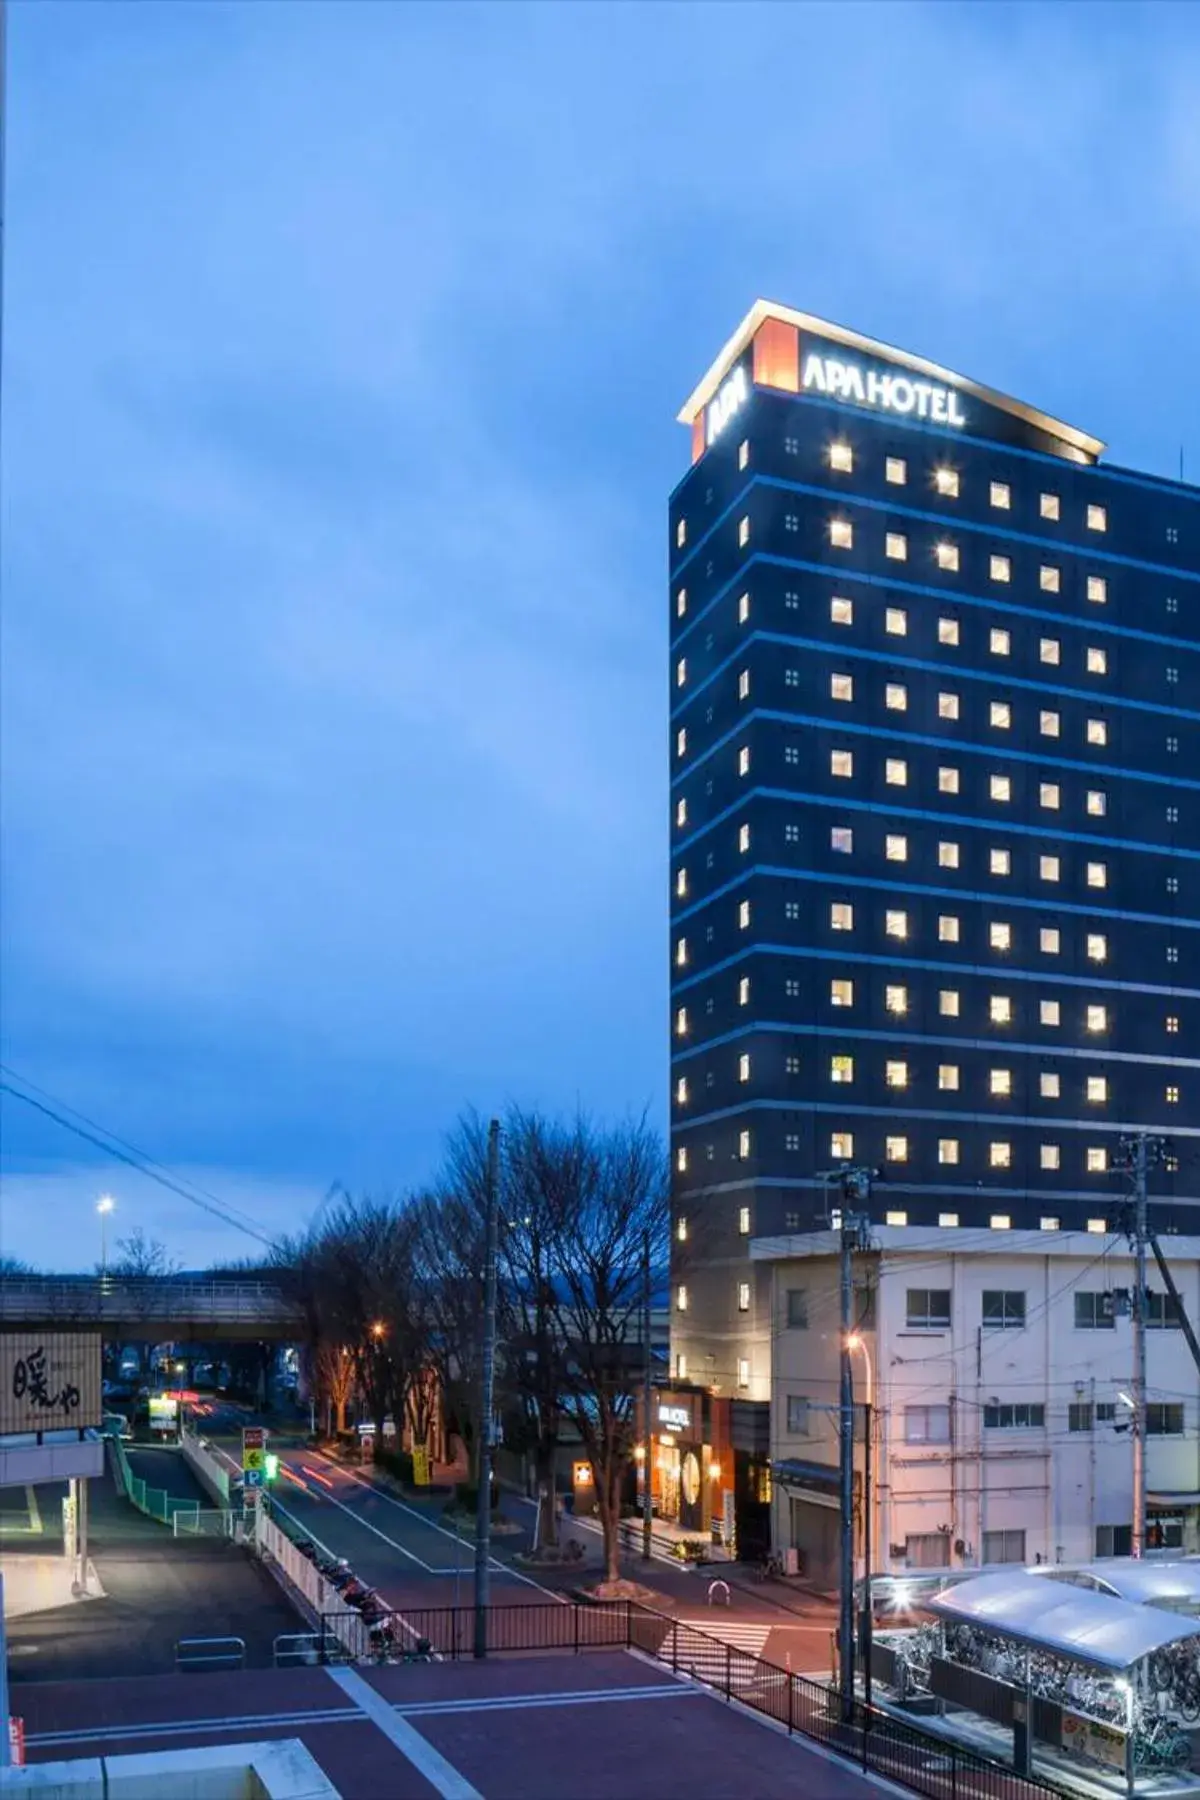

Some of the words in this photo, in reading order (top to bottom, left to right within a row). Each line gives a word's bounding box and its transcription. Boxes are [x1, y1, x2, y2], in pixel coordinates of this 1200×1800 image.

[803, 354, 866, 400] APA
[867, 371, 966, 426] HOTEL
[248, 1471, 260, 1485] P
